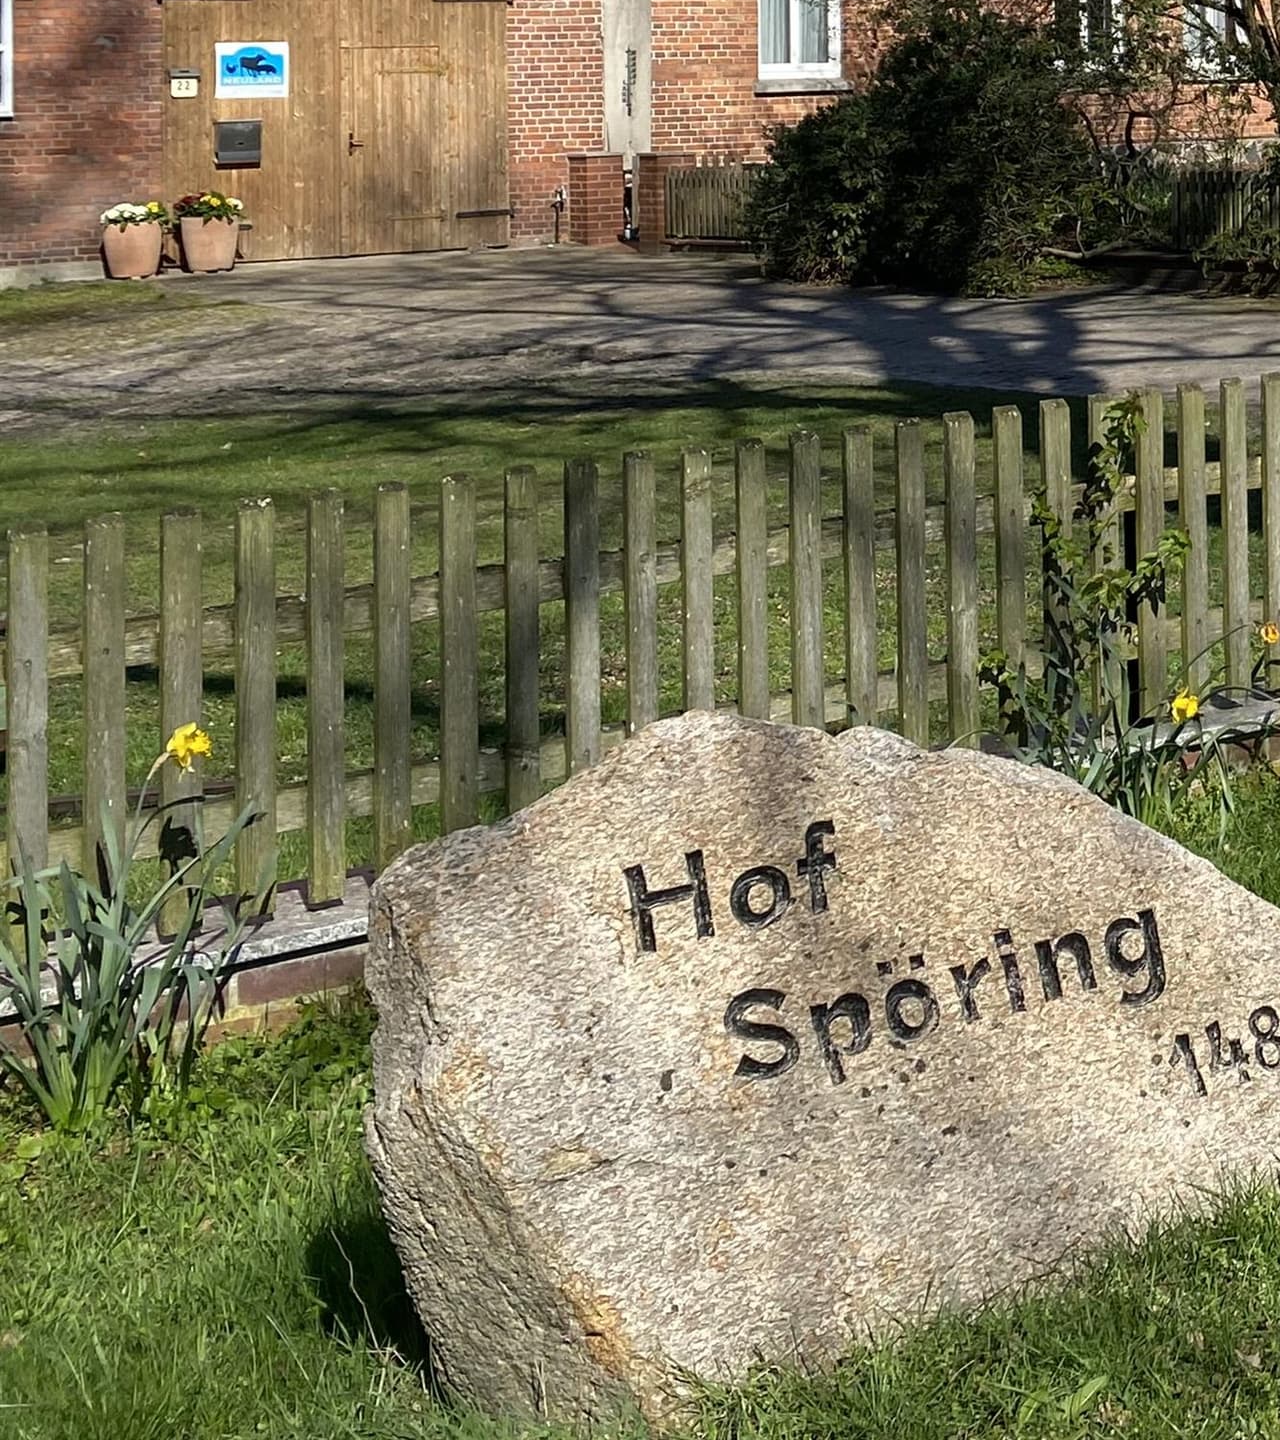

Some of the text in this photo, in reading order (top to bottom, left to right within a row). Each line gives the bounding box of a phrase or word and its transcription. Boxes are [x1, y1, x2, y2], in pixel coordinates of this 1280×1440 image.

[177, 81, 190, 90] 22
[621, 820, 838, 953] Hof
[722, 908, 1163, 1086] Spöring
